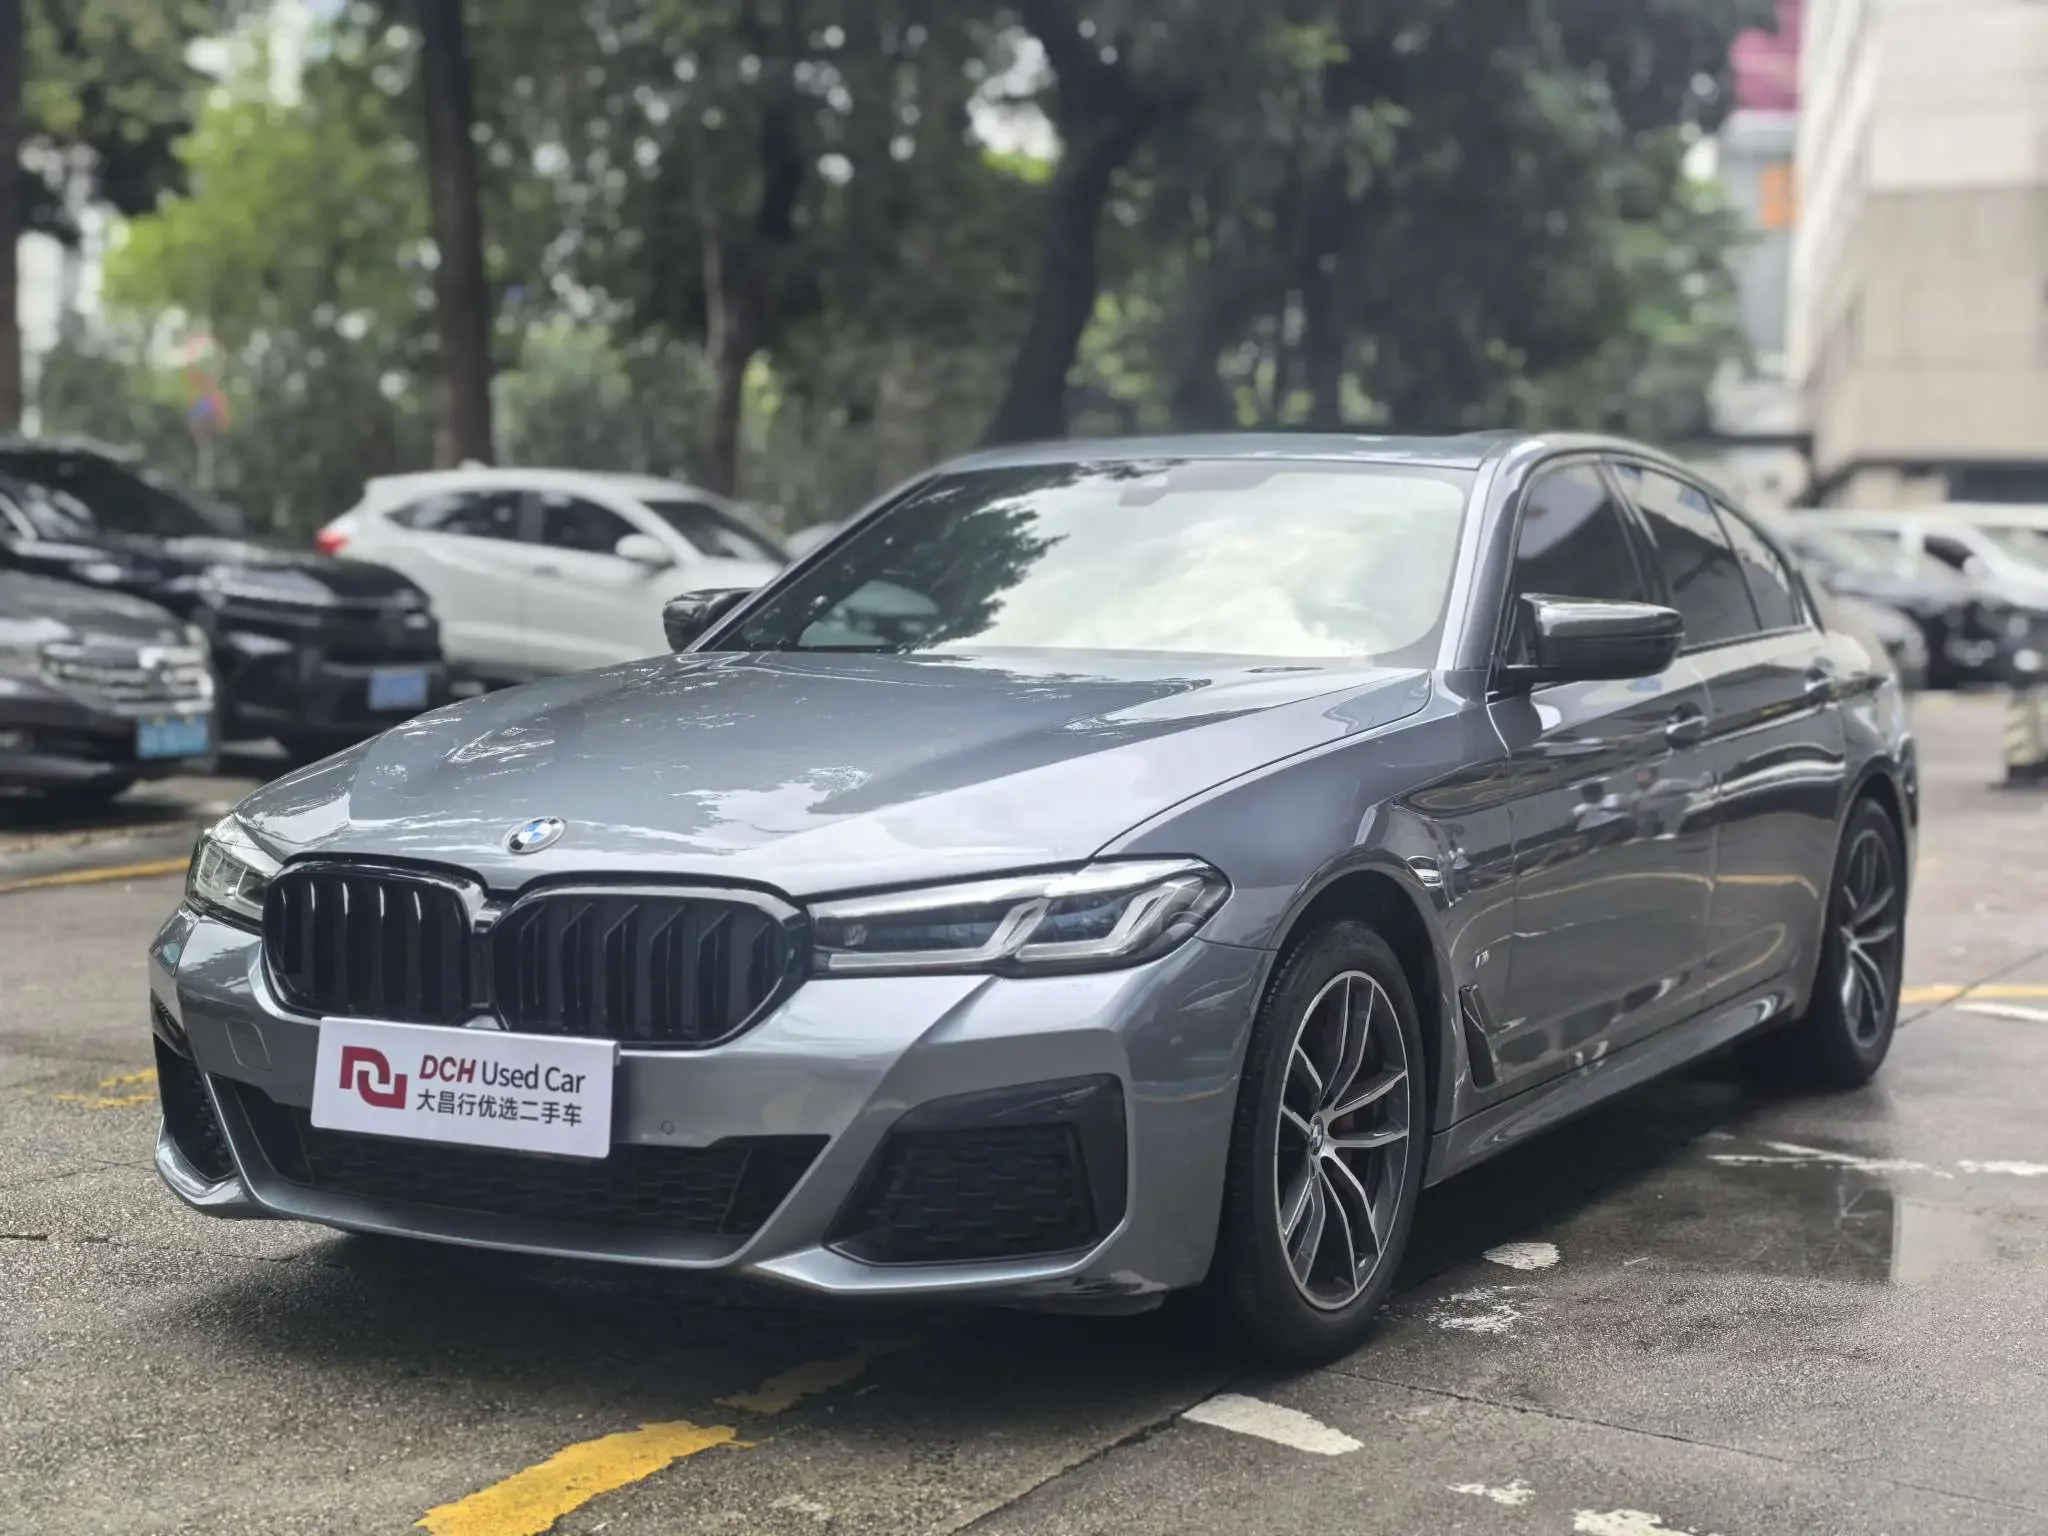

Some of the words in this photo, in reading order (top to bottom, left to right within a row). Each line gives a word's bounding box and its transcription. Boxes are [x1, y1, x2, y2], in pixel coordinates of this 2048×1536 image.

[419, 1054, 476, 1084] DCH
[482, 1061, 539, 1090] Used
[544, 1067, 586, 1094] Car
[416, 1089, 582, 1127] 大昌行优选二手车
